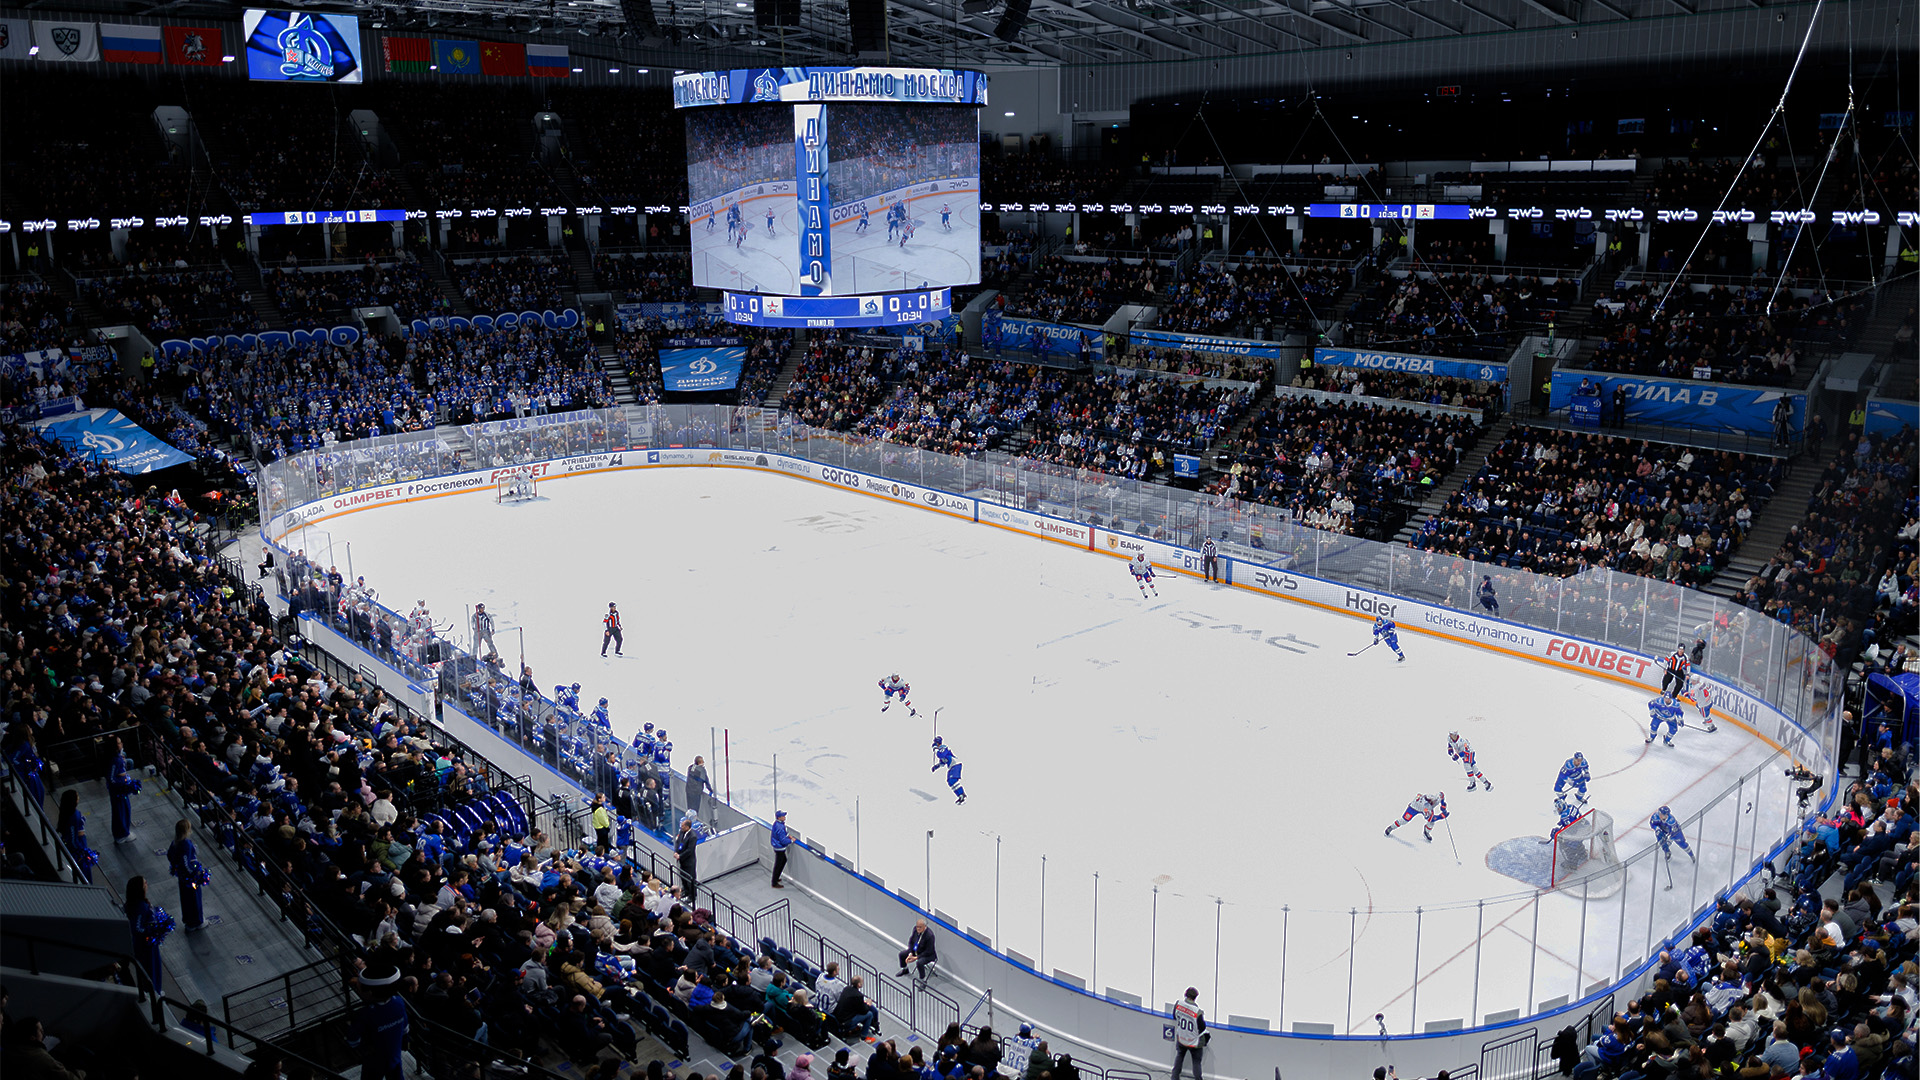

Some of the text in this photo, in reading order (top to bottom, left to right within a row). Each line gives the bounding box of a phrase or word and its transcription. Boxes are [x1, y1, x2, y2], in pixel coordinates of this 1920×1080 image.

[808, 71, 964, 99] ДИНАМО МОСКВА
[805, 117, 823, 284] ДИНАМО
[306, 212, 316, 223] 0
[346, 211, 355, 222] 0
[1361, 205, 1370, 217] 0
[1402, 205, 1411, 218] 0
[731, 296, 736, 310] 0
[750, 298, 758, 312] 0
[890, 297, 900, 312] 0
[919, 295, 927, 309] 0
[735, 312, 753, 323] 10:34
[897, 311, 922, 322] 10:34
[1001, 322, 1023, 335] МЫ
[1025, 326, 1032, 336] С
[1180, 336, 1251, 354] ДИНАМО
[1353, 353, 1434, 373] МОСКВА
[676, 376, 727, 384] ДИНАМО
[1622, 383, 1719, 406] СИЛА В
[562, 454, 609, 467] ATRIBUTIKA
[724, 454, 755, 462] GISLAVED
[777, 457, 811, 473] dynamo.ru
[416, 476, 483, 495] Ростелеком
[866, 479, 915, 500] Яндекс Про
[333, 487, 403, 509] OLIMPBET
[945, 498, 969, 512] LADA
[301, 505, 325, 519] LADA
[1034, 519, 1086, 540] OLIMPBET
[1120, 540, 1145, 552] БАНК
[1345, 590, 1398, 618] Haier
[1425, 610, 1535, 648] tickets.dynamo.ru
[1545, 638, 1653, 679] FONBET
[1165, 1028, 1173, 1037] 6
